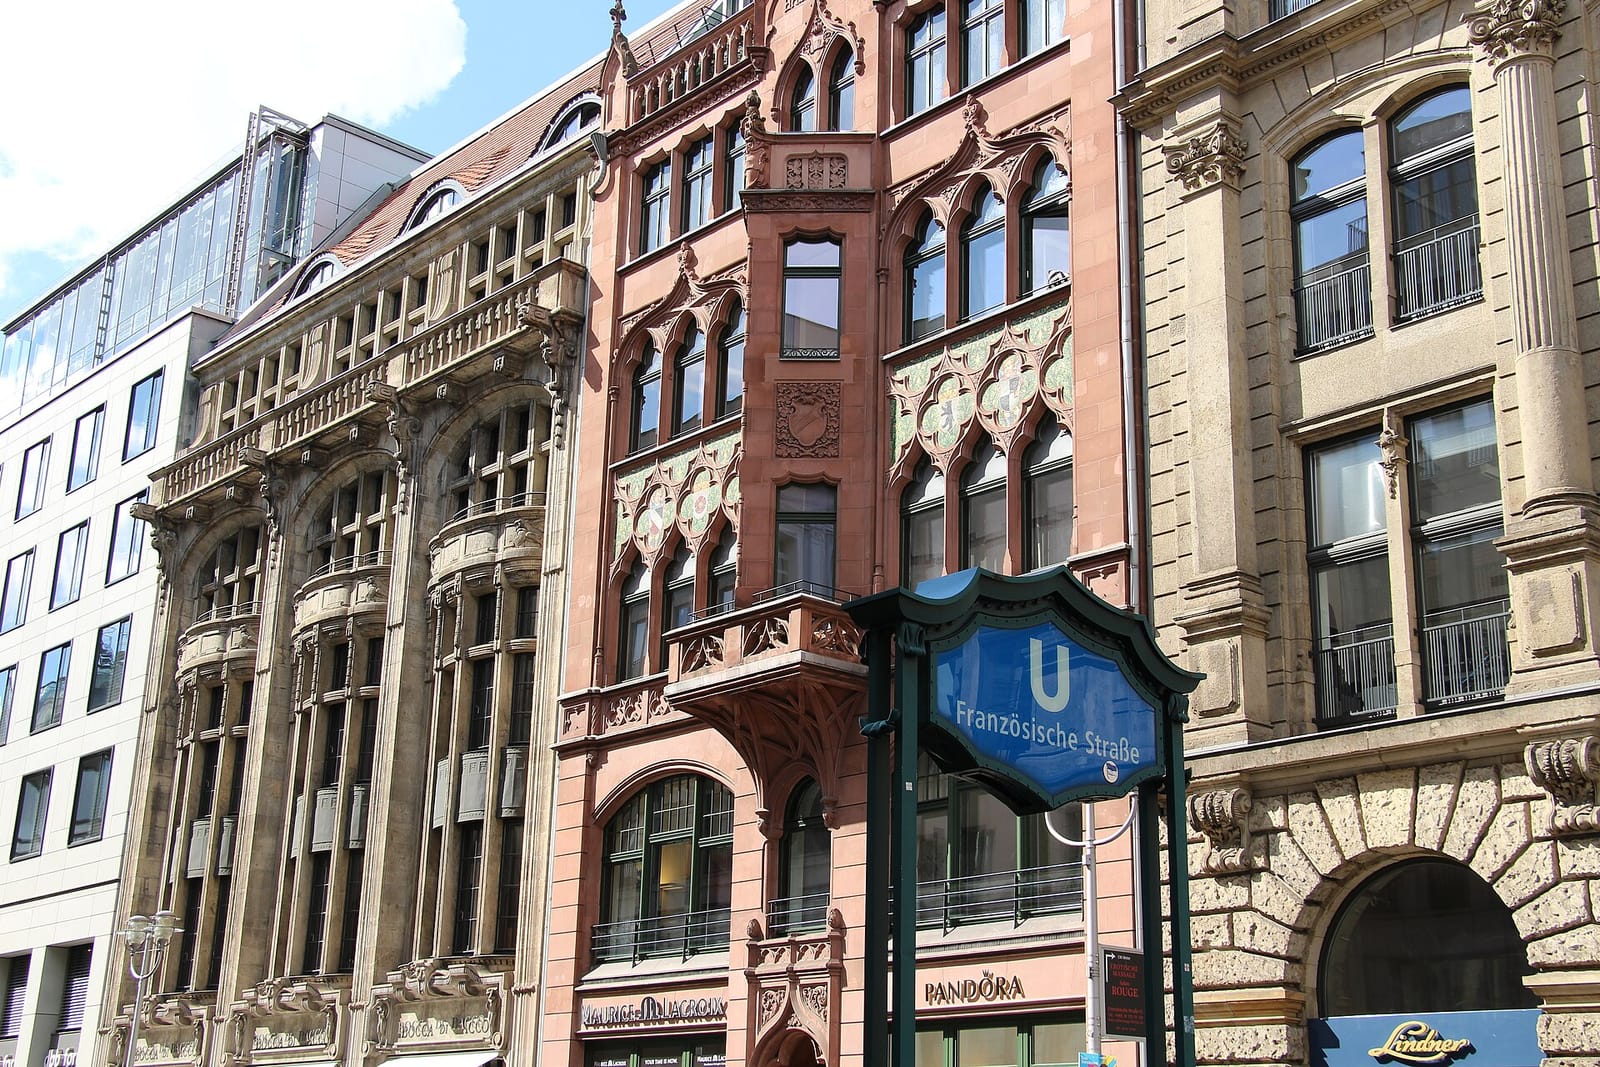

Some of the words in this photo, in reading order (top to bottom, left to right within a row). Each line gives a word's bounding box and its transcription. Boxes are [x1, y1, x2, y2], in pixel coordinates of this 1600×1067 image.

[1030, 638, 1070, 712] U
[956, 700, 1077, 750] Französische
[1085, 730, 1140, 764] Straße
[925, 974, 1023, 1003] PANDORA
[1111, 986, 1139, 998] ROUGE
[582, 1003, 635, 1026] MAURICE
[663, 997, 724, 1018] LACROIX
[1368, 1021, 1470, 1063] Lindner
